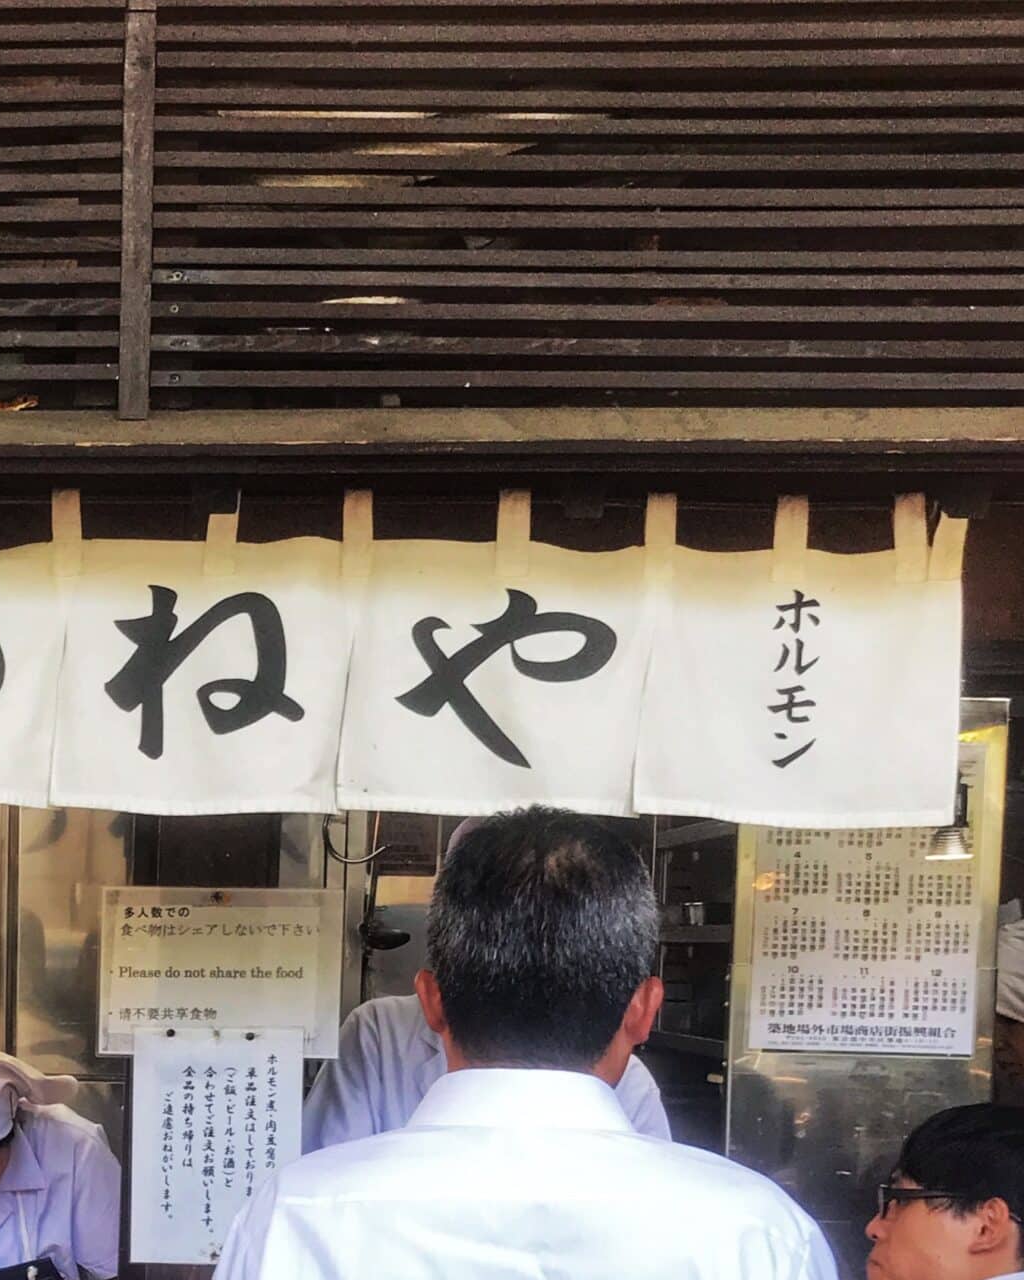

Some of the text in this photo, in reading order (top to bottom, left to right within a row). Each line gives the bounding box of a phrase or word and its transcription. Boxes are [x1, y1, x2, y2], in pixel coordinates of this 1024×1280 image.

[770, 589, 821, 768] ホルモン
[123, 906, 191, 919] 多人数での
[119, 966, 304, 979] Please do not share the food
